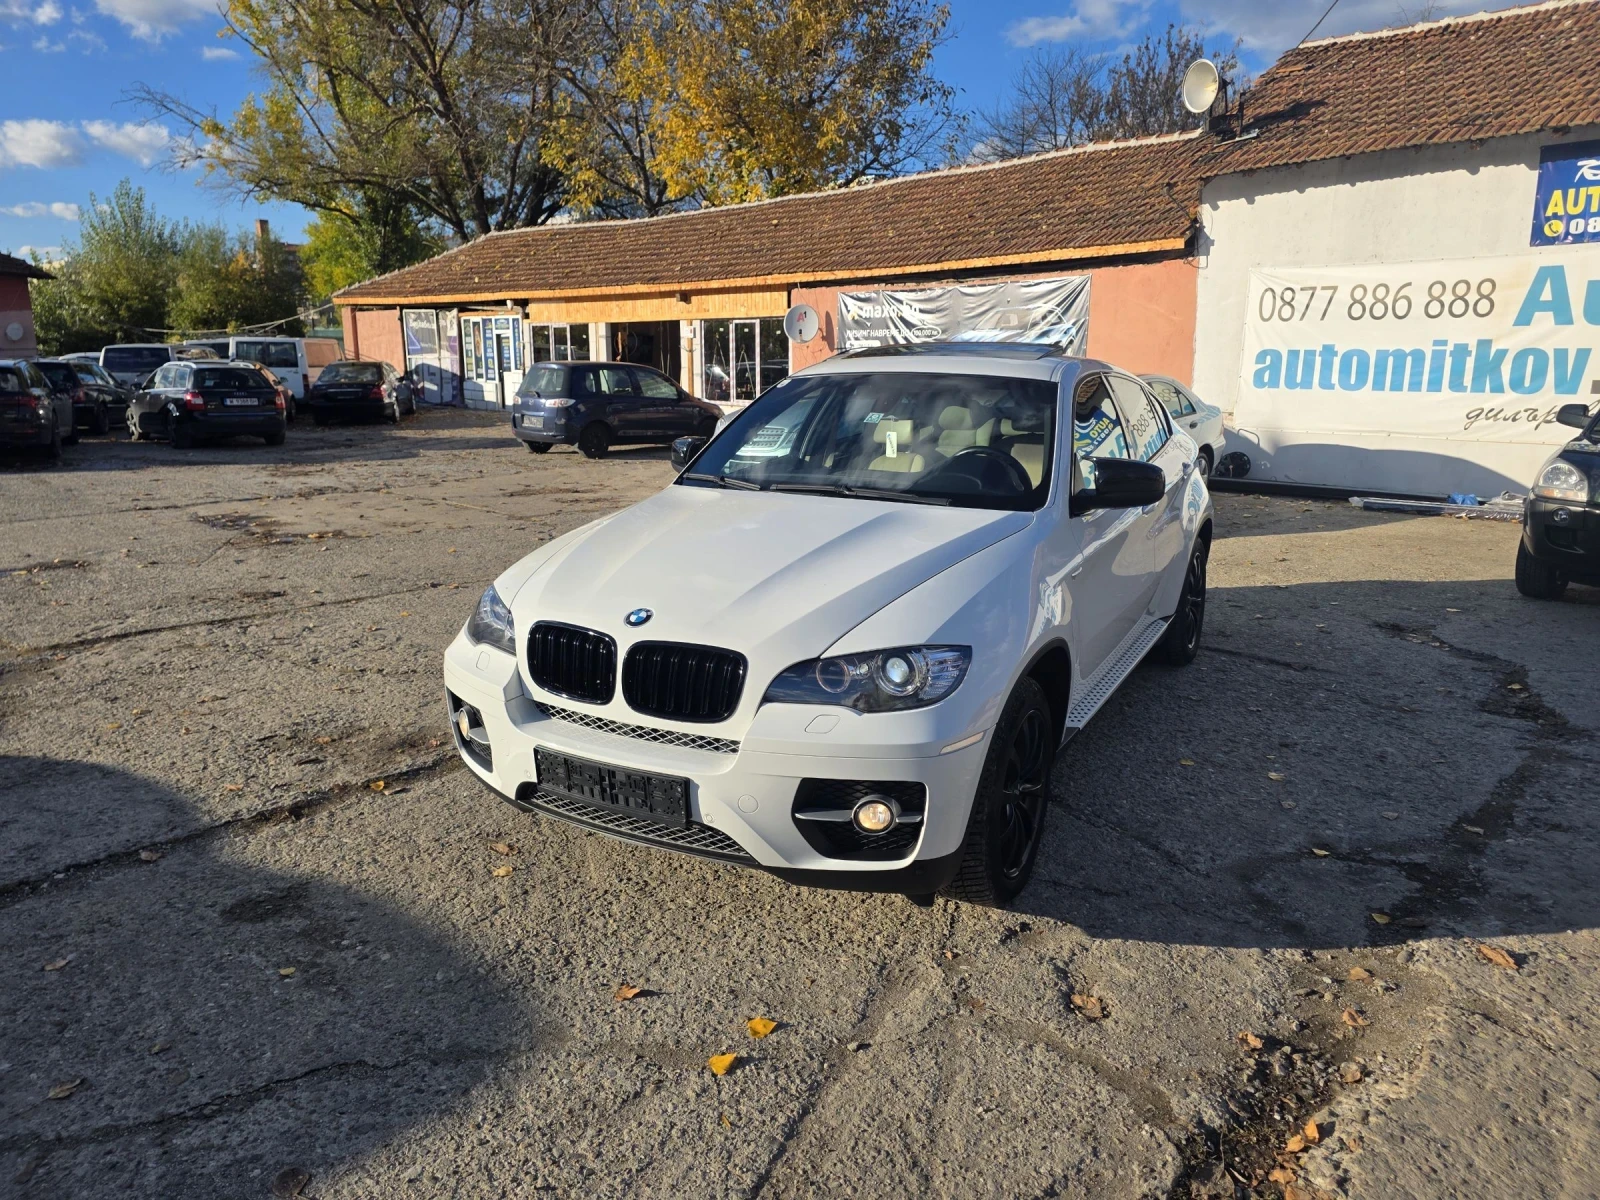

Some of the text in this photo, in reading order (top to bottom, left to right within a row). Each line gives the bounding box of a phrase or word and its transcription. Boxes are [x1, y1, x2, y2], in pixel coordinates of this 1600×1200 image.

[1569, 217, 1600, 234] 08
[1258, 278, 1497, 322] 0877 886 888
[797, 311, 806, 322] A1
